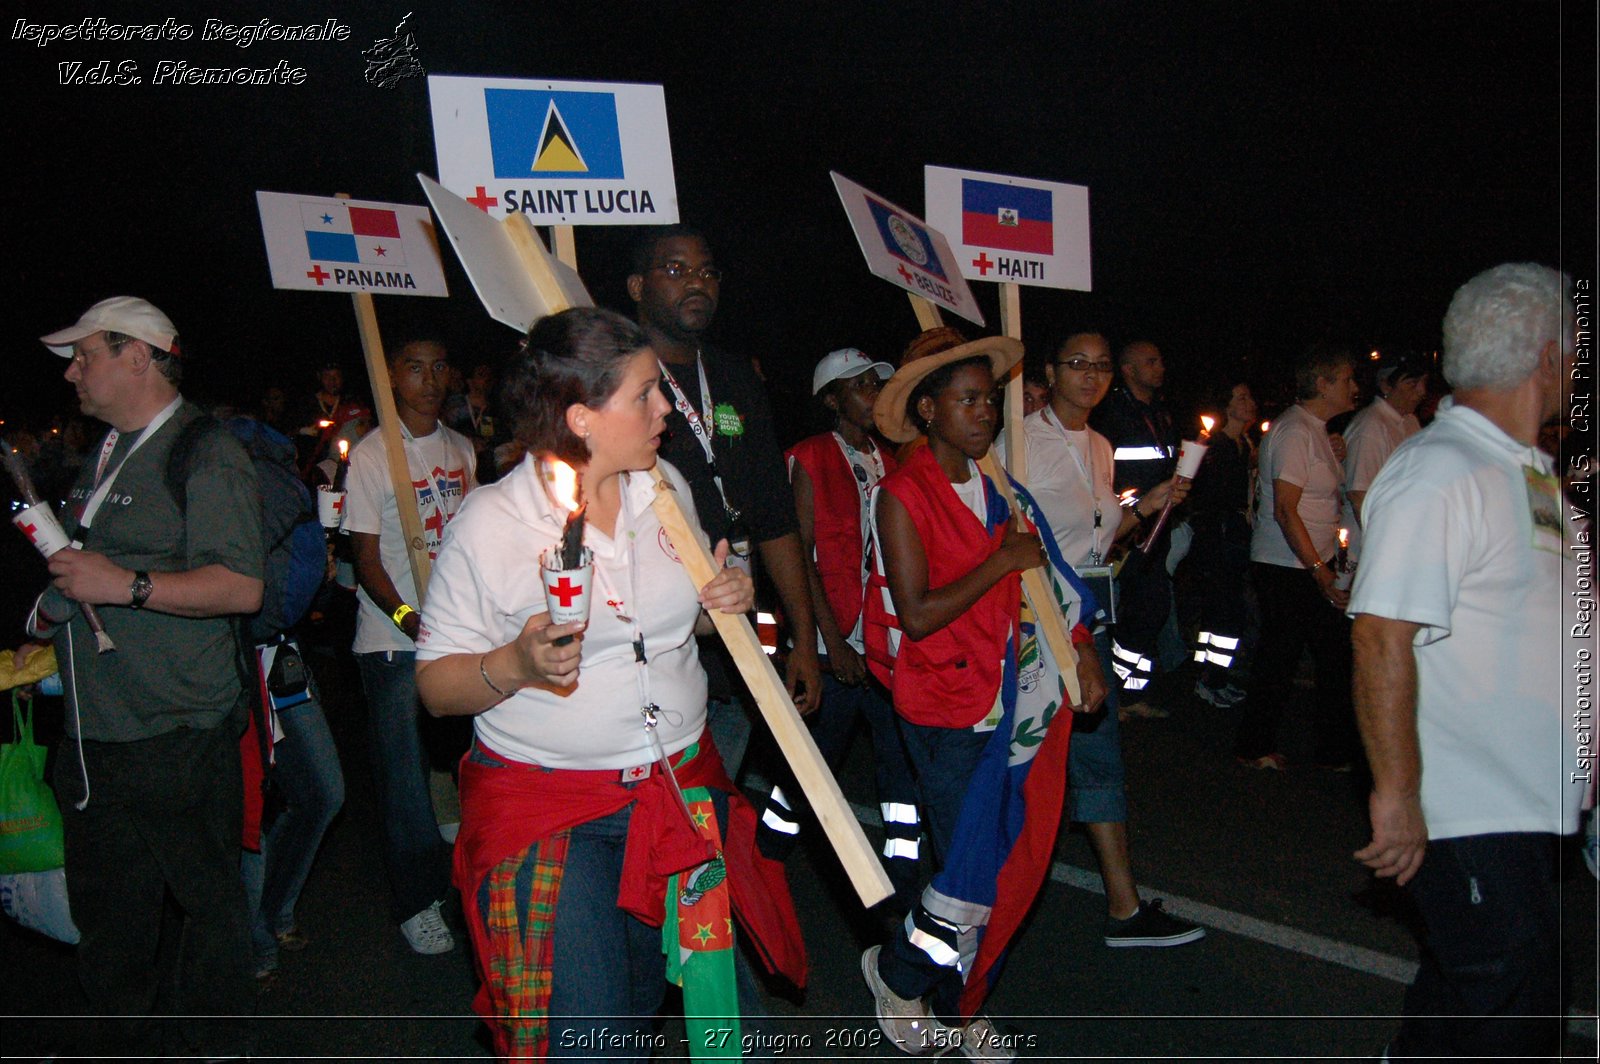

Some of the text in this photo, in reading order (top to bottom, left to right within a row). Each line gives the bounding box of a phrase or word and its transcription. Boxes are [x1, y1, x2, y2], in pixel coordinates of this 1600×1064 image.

[503, 189, 656, 214] SAINT LUCIA
[333, 268, 417, 290] PANAMA
[998, 256, 1045, 280] HAITI
[913, 271, 958, 307] BELIZE
[719, 413, 741, 422] YOUTH
